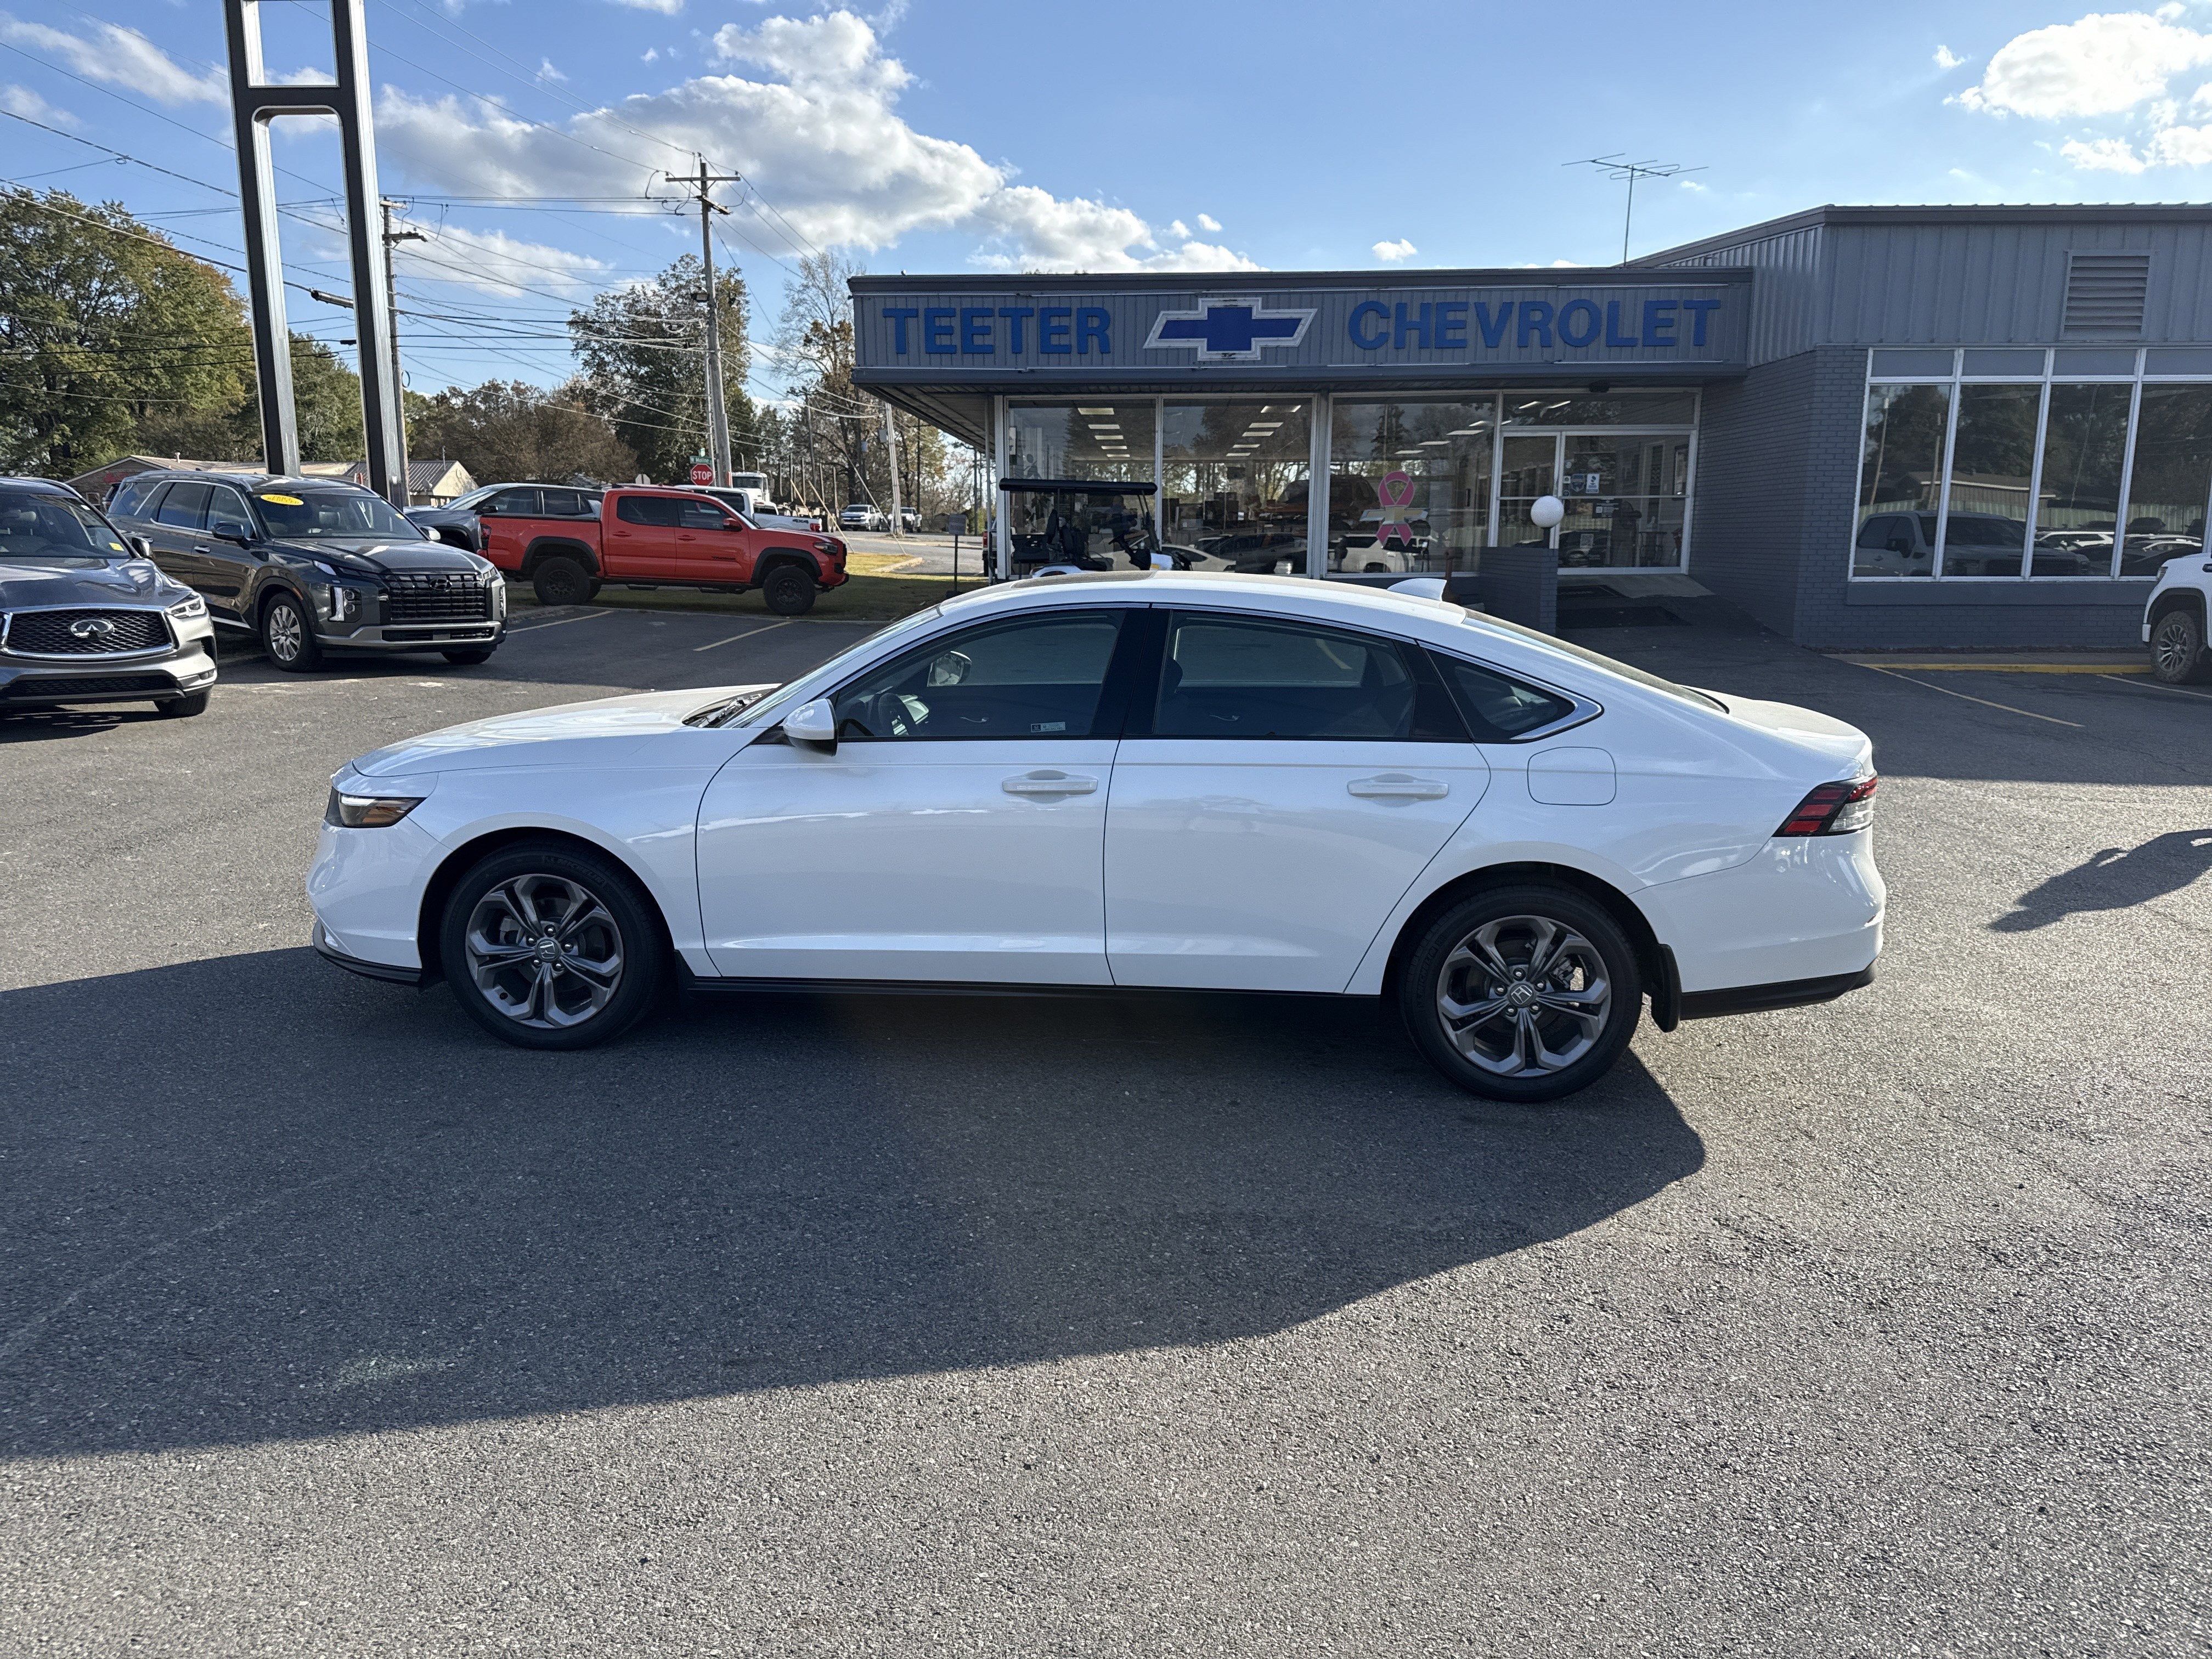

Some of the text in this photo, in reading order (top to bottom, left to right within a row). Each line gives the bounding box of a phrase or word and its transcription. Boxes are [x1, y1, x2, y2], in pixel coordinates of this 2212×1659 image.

[882, 298, 1721, 354] TEETER CHEVROLET
[692, 471, 712, 481] STOP
